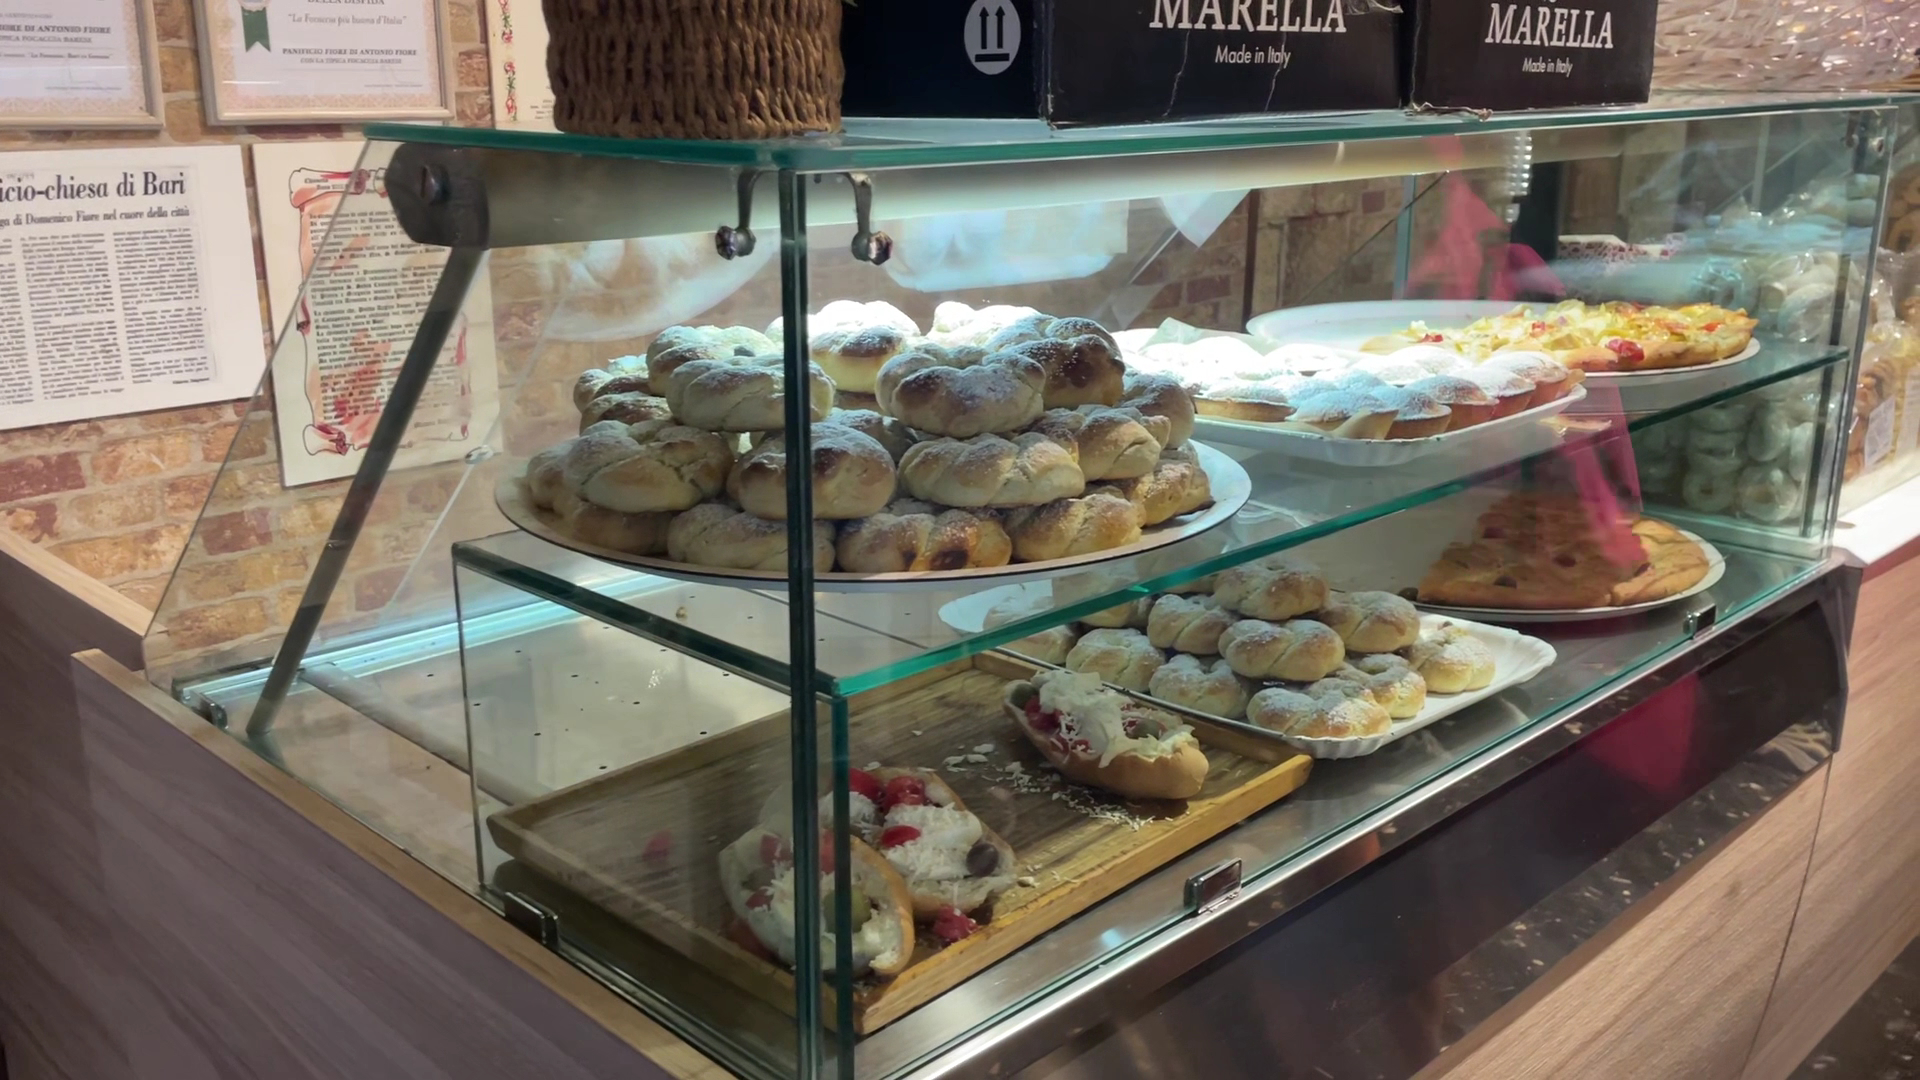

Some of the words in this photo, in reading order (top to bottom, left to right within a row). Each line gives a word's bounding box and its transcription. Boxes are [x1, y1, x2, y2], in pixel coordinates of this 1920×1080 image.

[1149, 0, 1347, 32] MARELLA
[1485, 3, 1613, 49] MARELLA
[37, 25, 82, 33] ANTONIO
[83, 26, 111, 34] FIORE
[1215, 44, 1252, 64] Made
[1255, 46, 1264, 64] in
[1267, 44, 1291, 69] Italy
[1522, 56, 1546, 73] Made
[1547, 58, 1555, 73] in
[1555, 57, 1573, 77] Italy
[117, 172, 136, 197] di
[143, 171, 186, 196] Bari
[13, 214, 23, 226] di
[26, 211, 73, 225] Domenico
[76, 210, 100, 223] Fiore
[103, 209, 117, 221] nel
[119, 210, 144, 221] cuore
[147, 206, 168, 219] della
